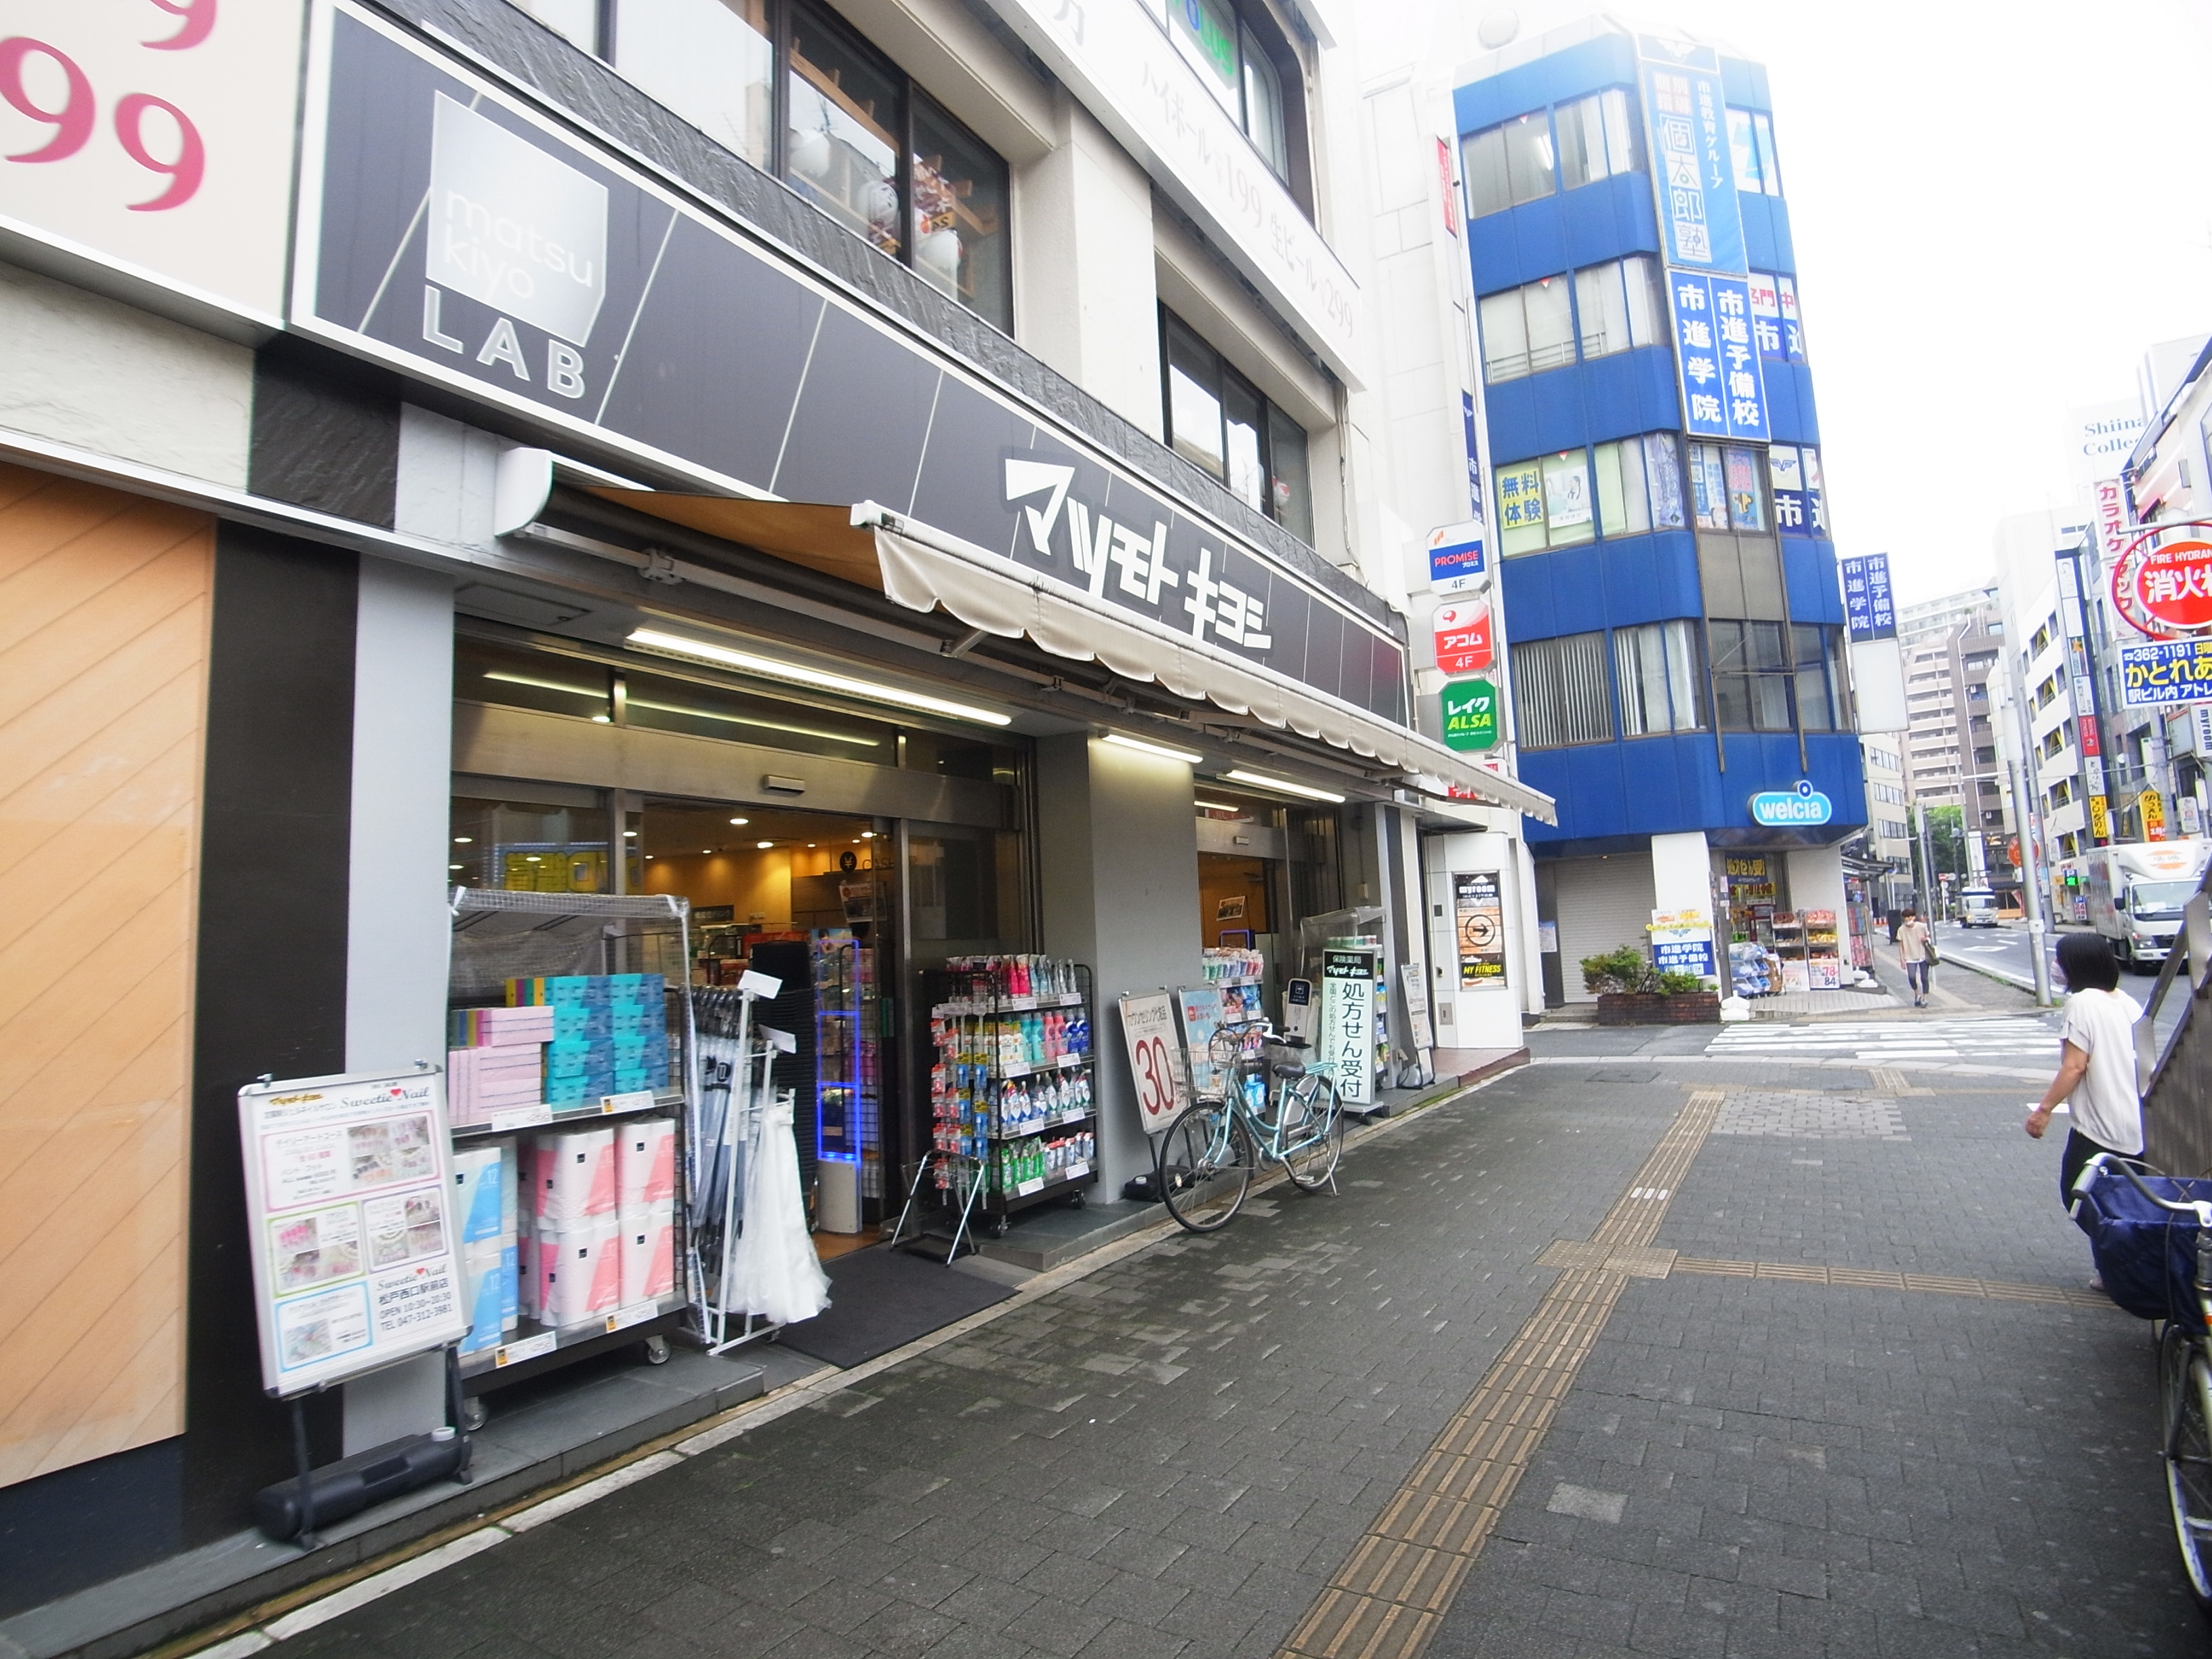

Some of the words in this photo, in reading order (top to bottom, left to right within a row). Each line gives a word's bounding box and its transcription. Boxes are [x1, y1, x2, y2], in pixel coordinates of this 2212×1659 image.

[446, 188, 594, 290] matsu
[443, 224, 535, 305] kiyo
[422, 285, 586, 400] LAB
[1677, 283, 1722, 423] 市進学院
[1717, 289, 1761, 427] 市進予備校
[1502, 470, 1539, 499] 無料
[1504, 497, 1542, 527] 体験
[2100, 485, 2125, 553] カラオケ
[1435, 550, 1479, 568] PROMISE
[1462, 560, 1479, 569] プロミス
[2150, 552, 2172, 565] FIRE
[1451, 578, 1466, 590] 4F
[1845, 560, 1870, 630] 市進学院
[1867, 556, 1893, 628] 市進予備校
[1443, 632, 1483, 650] アコム
[1455, 655, 1473, 668] 4F
[2128, 685, 2178, 703] 駅ビル内
[1448, 696, 1490, 716] レイク
[1447, 713, 1492, 731] ALSA
[1759, 797, 1822, 820] welcia
[1332, 954, 1361, 964] 保険薬局
[1463, 966, 1475, 975] MY
[1475, 964, 1502, 974] FITNESS
[1340, 981, 1365, 1098] 処方せん受付
[1135, 1036, 1174, 1115] 30
[339, 1092, 393, 1109] Sweetie
[397, 1087, 430, 1101] Nail
